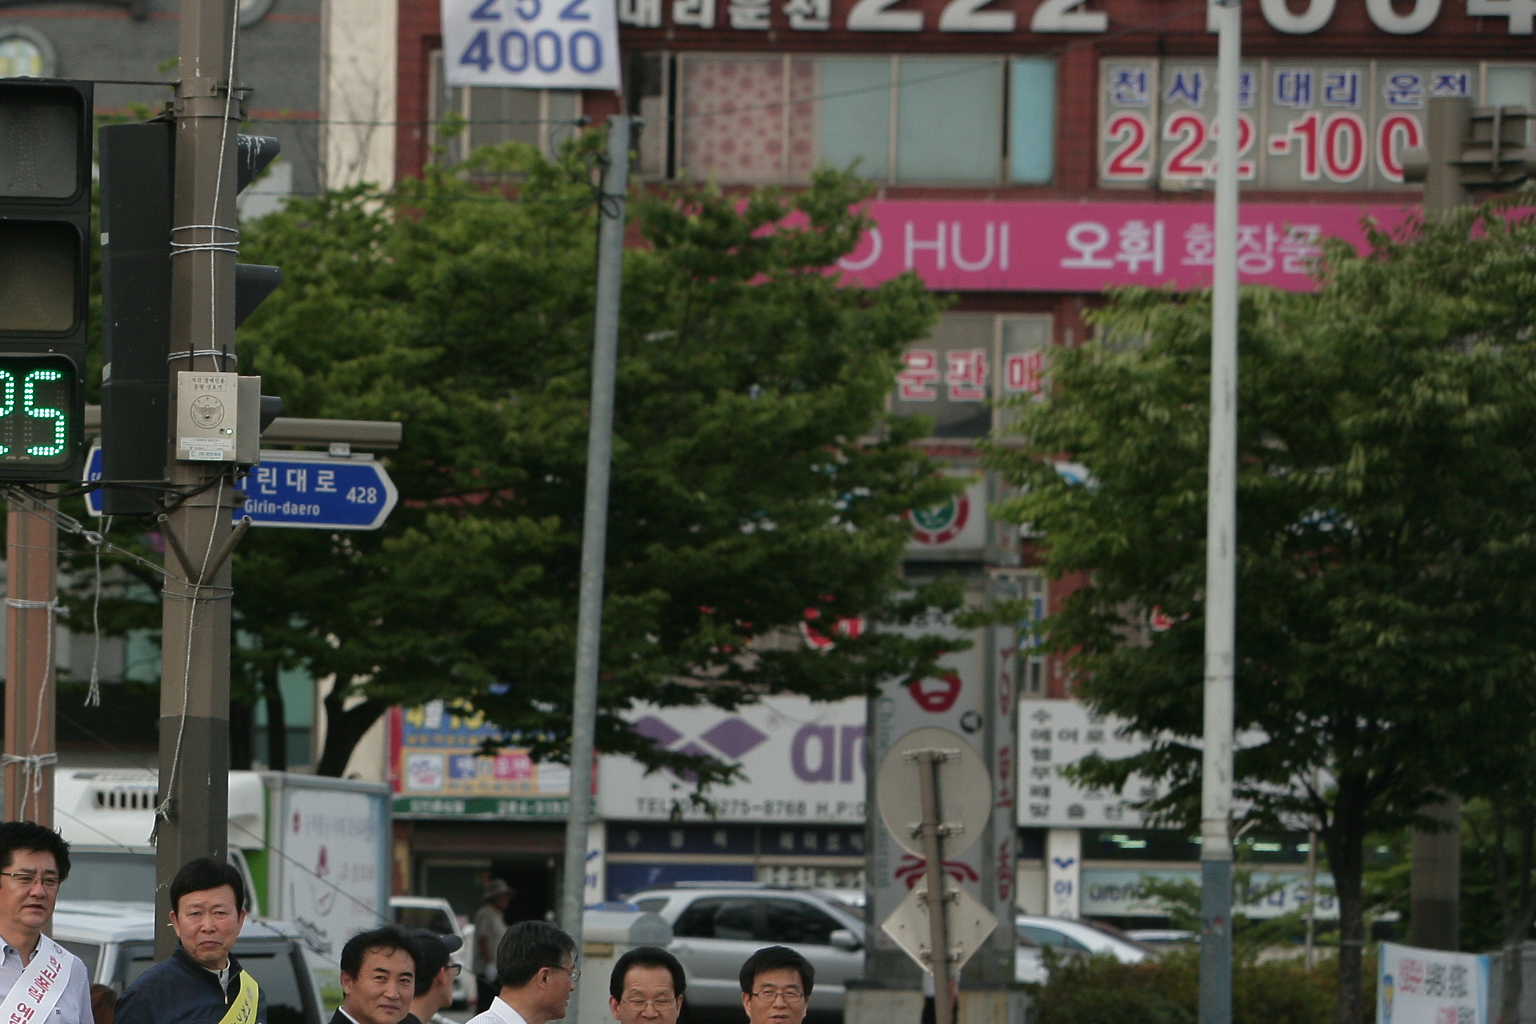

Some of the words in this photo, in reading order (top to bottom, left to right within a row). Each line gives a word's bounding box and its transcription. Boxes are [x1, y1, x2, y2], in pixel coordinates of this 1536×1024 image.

[460, 30, 603, 73] 4000
[904, 221, 1010, 271] HUI
[1060, 218, 1166, 275] 오휘
[244, 498, 320, 516] Girin-daero
[346, 486, 378, 505] 428
[791, 722, 867, 784] ar
[27, 954, 64, 1005] 학교폭력
